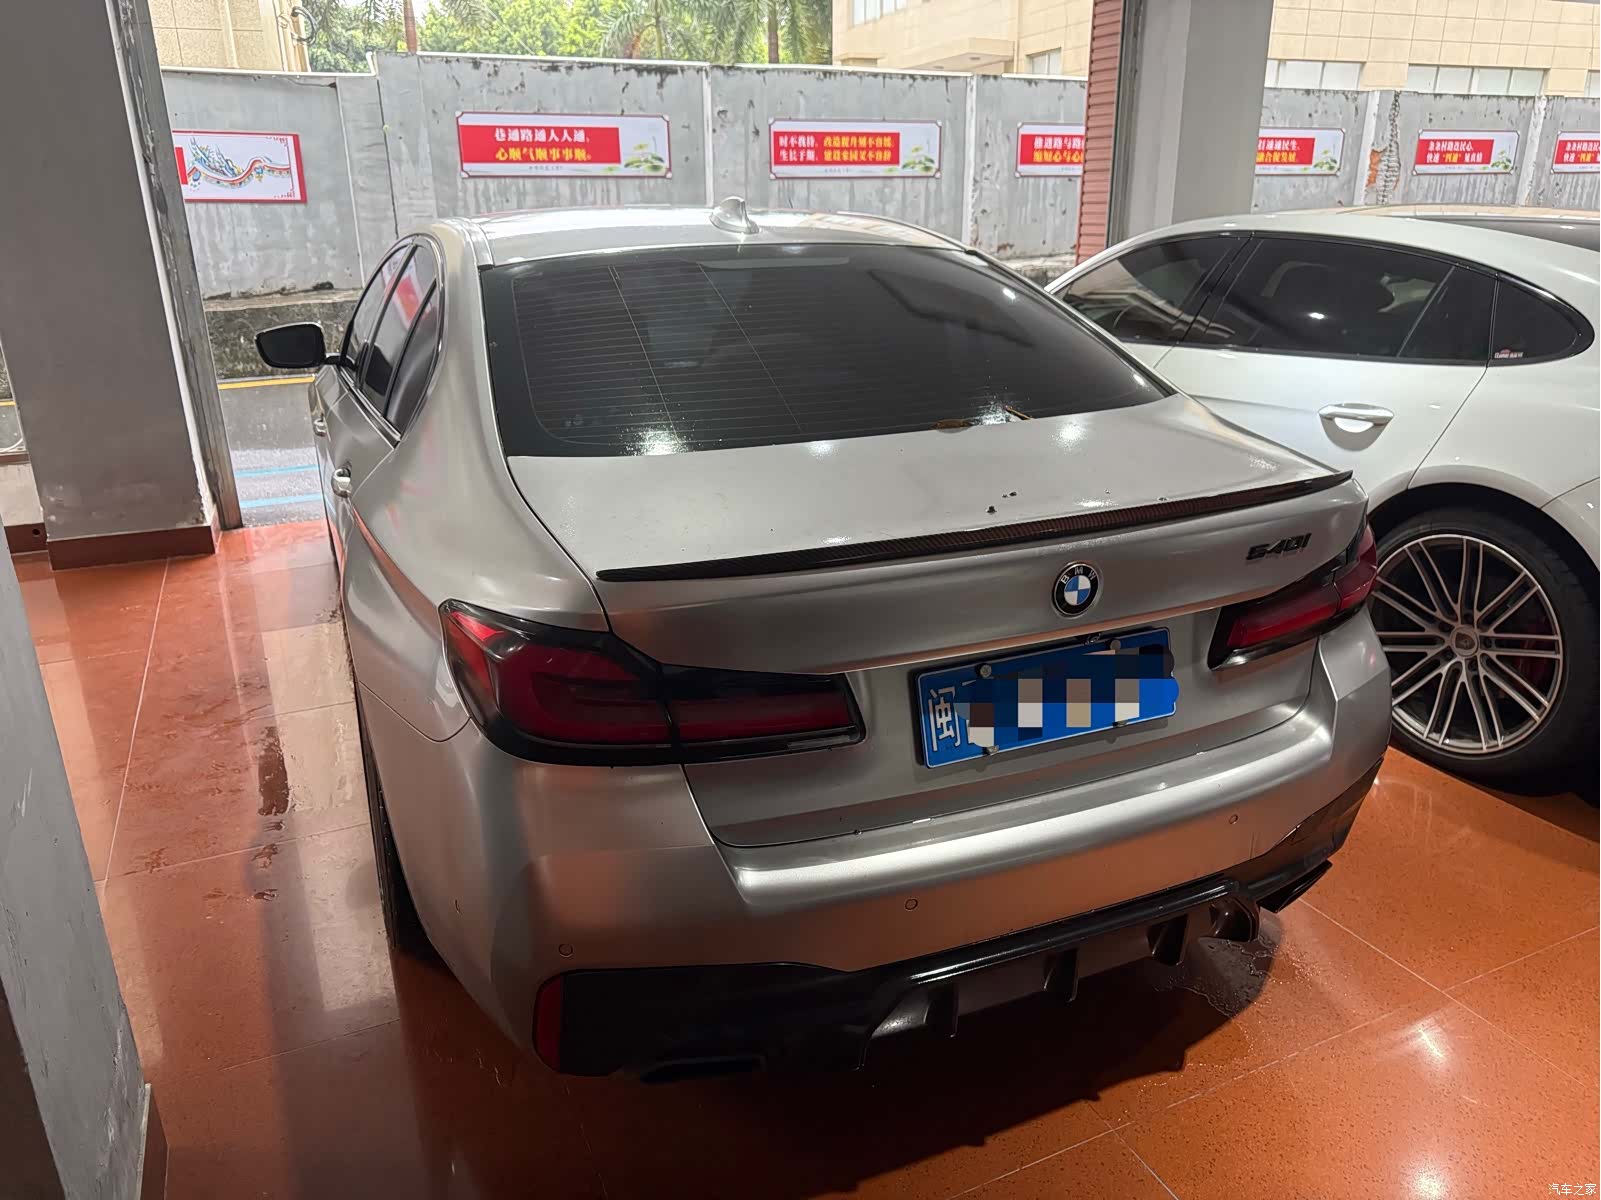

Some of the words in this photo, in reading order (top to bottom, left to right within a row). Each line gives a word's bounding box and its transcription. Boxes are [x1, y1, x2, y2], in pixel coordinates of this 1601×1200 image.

[1033, 150, 1083, 163] 缩短心与心
[1060, 566, 1097, 585] BMW
[928, 686, 961, 752] 闽
